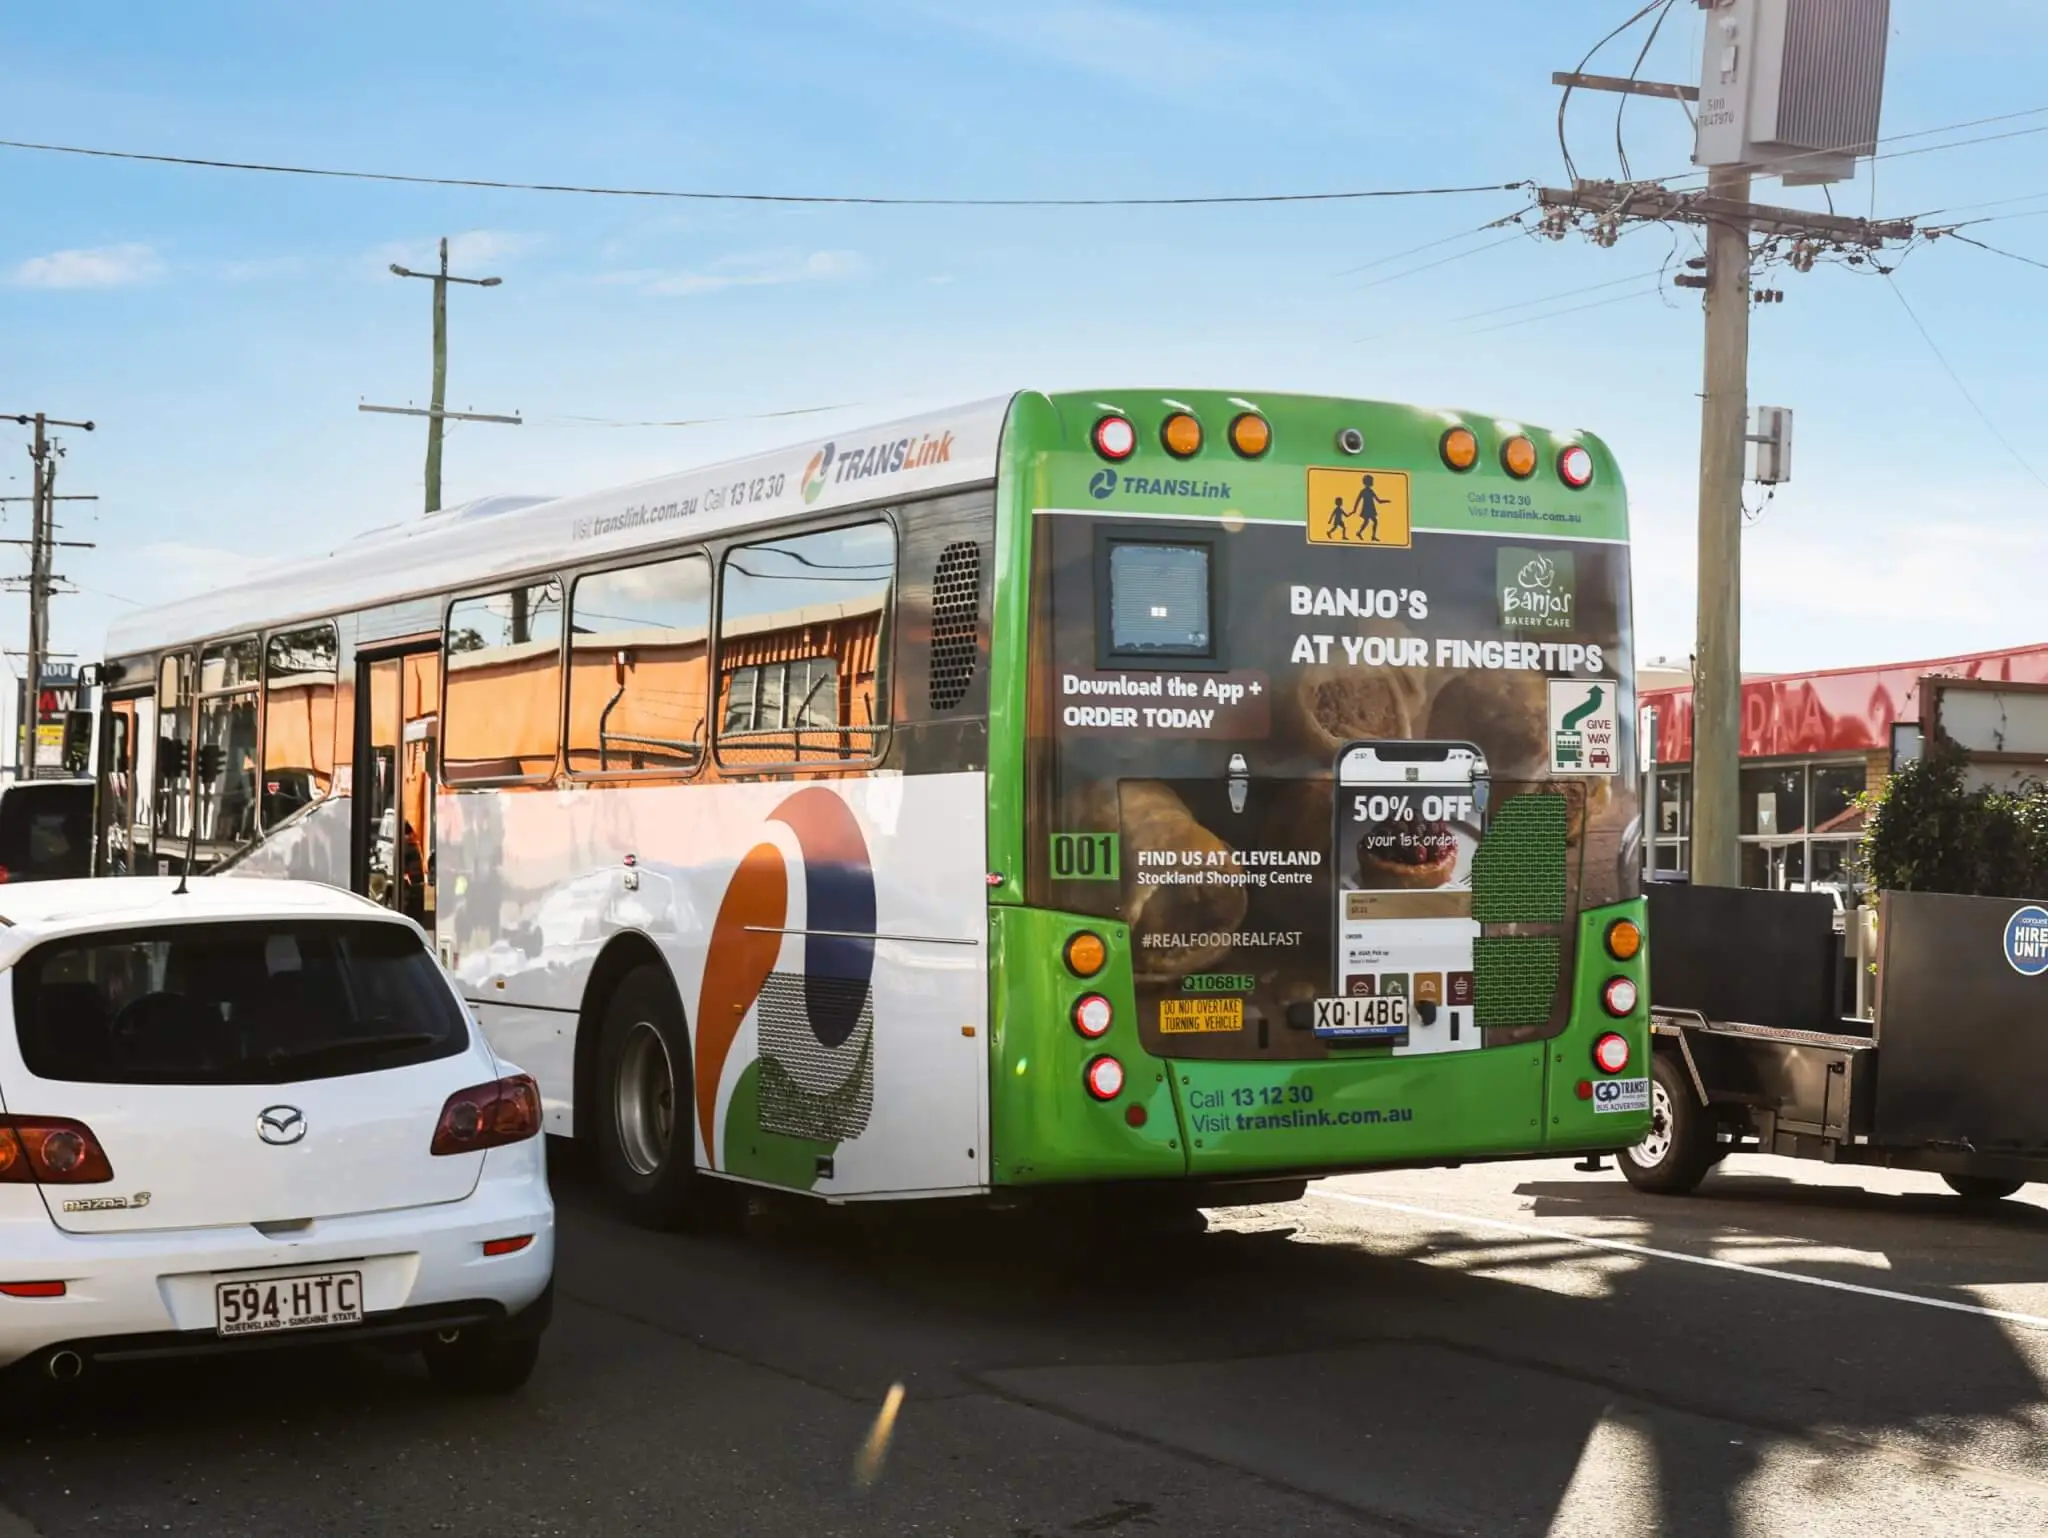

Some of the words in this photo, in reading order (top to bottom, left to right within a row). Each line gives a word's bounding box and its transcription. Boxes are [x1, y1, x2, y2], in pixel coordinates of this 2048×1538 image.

[834, 430, 953, 483] TRANSLink
[1123, 477, 1231, 498] TRANSLink
[594, 497, 698, 536] translink.com.au
[703, 488, 726, 512] Call
[731, 482, 744, 506] 13
[750, 477, 762, 502] 12
[768, 472, 785, 499] 30
[1467, 492, 1486, 503] Call
[1489, 493, 1500, 504] 13
[1502, 494, 1515, 505] 12
[1518, 495, 1531, 506] 30
[1490, 508, 1581, 522] translink.com.au
[1505, 616, 1541, 626] BAKERY
[1546, 618, 1571, 628] CAFE
[1291, 635, 1335, 665] AT
[1341, 637, 1429, 668] YOUR
[1436, 639, 1604, 673] FINGERTIPS
[1063, 674, 1162, 697] Download
[1167, 676, 1198, 697] the
[1203, 678, 1244, 705] App
[1249, 681, 1262, 695] +
[1063, 707, 1138, 727] ORDER
[1142, 708, 1215, 728] TODAY
[1587, 720, 1611, 729] GIVE
[1587, 734, 1611, 744] WAY
[1353, 795, 1414, 822] 50%
[1422, 796, 1473, 821] OFF
[1367, 835, 1396, 849] your
[1400, 833, 1418, 847] 1st
[1423, 833, 1459, 847] order
[1055, 836, 1112, 875] 001
[1138, 851, 1177, 865] FIND
[1181, 851, 1203, 866] US
[1206, 851, 1225, 865] AT
[1231, 851, 1321, 865] CLEVELAND
[1137, 871, 1203, 885] Stockland
[1206, 871, 1267, 887] Shopping
[1269, 872, 1313, 884] Centre
[1141, 931, 1303, 948] #REALFOODREALFAST
[2015, 927, 2048, 942] HIRE
[2014, 942, 2048, 957] UNIT
[1183, 976, 1254, 989] Q106815
[1164, 1000, 1175, 1014] DO
[1179, 1000, 1193, 1013] NOT
[1197, 999, 1239, 1013] OVERTAKE
[1165, 1016, 1200, 1030] TURNING
[1204, 1015, 1240, 1029] VEHICLE
[1620, 1081, 1648, 1093] TRANSIT
[1189, 1090, 1225, 1109] Call
[1231, 1088, 1254, 1106] 13
[1258, 1087, 1283, 1105] 12
[1288, 1085, 1313, 1103] 30
[1192, 1113, 1231, 1132] Visit
[1236, 1107, 1413, 1131] translink.com.au
[224, 1319, 280, 1332] QUEENSLAND
[289, 1315, 328, 1326] SUNSHINE
[332, 1312, 356, 1321] STATE
